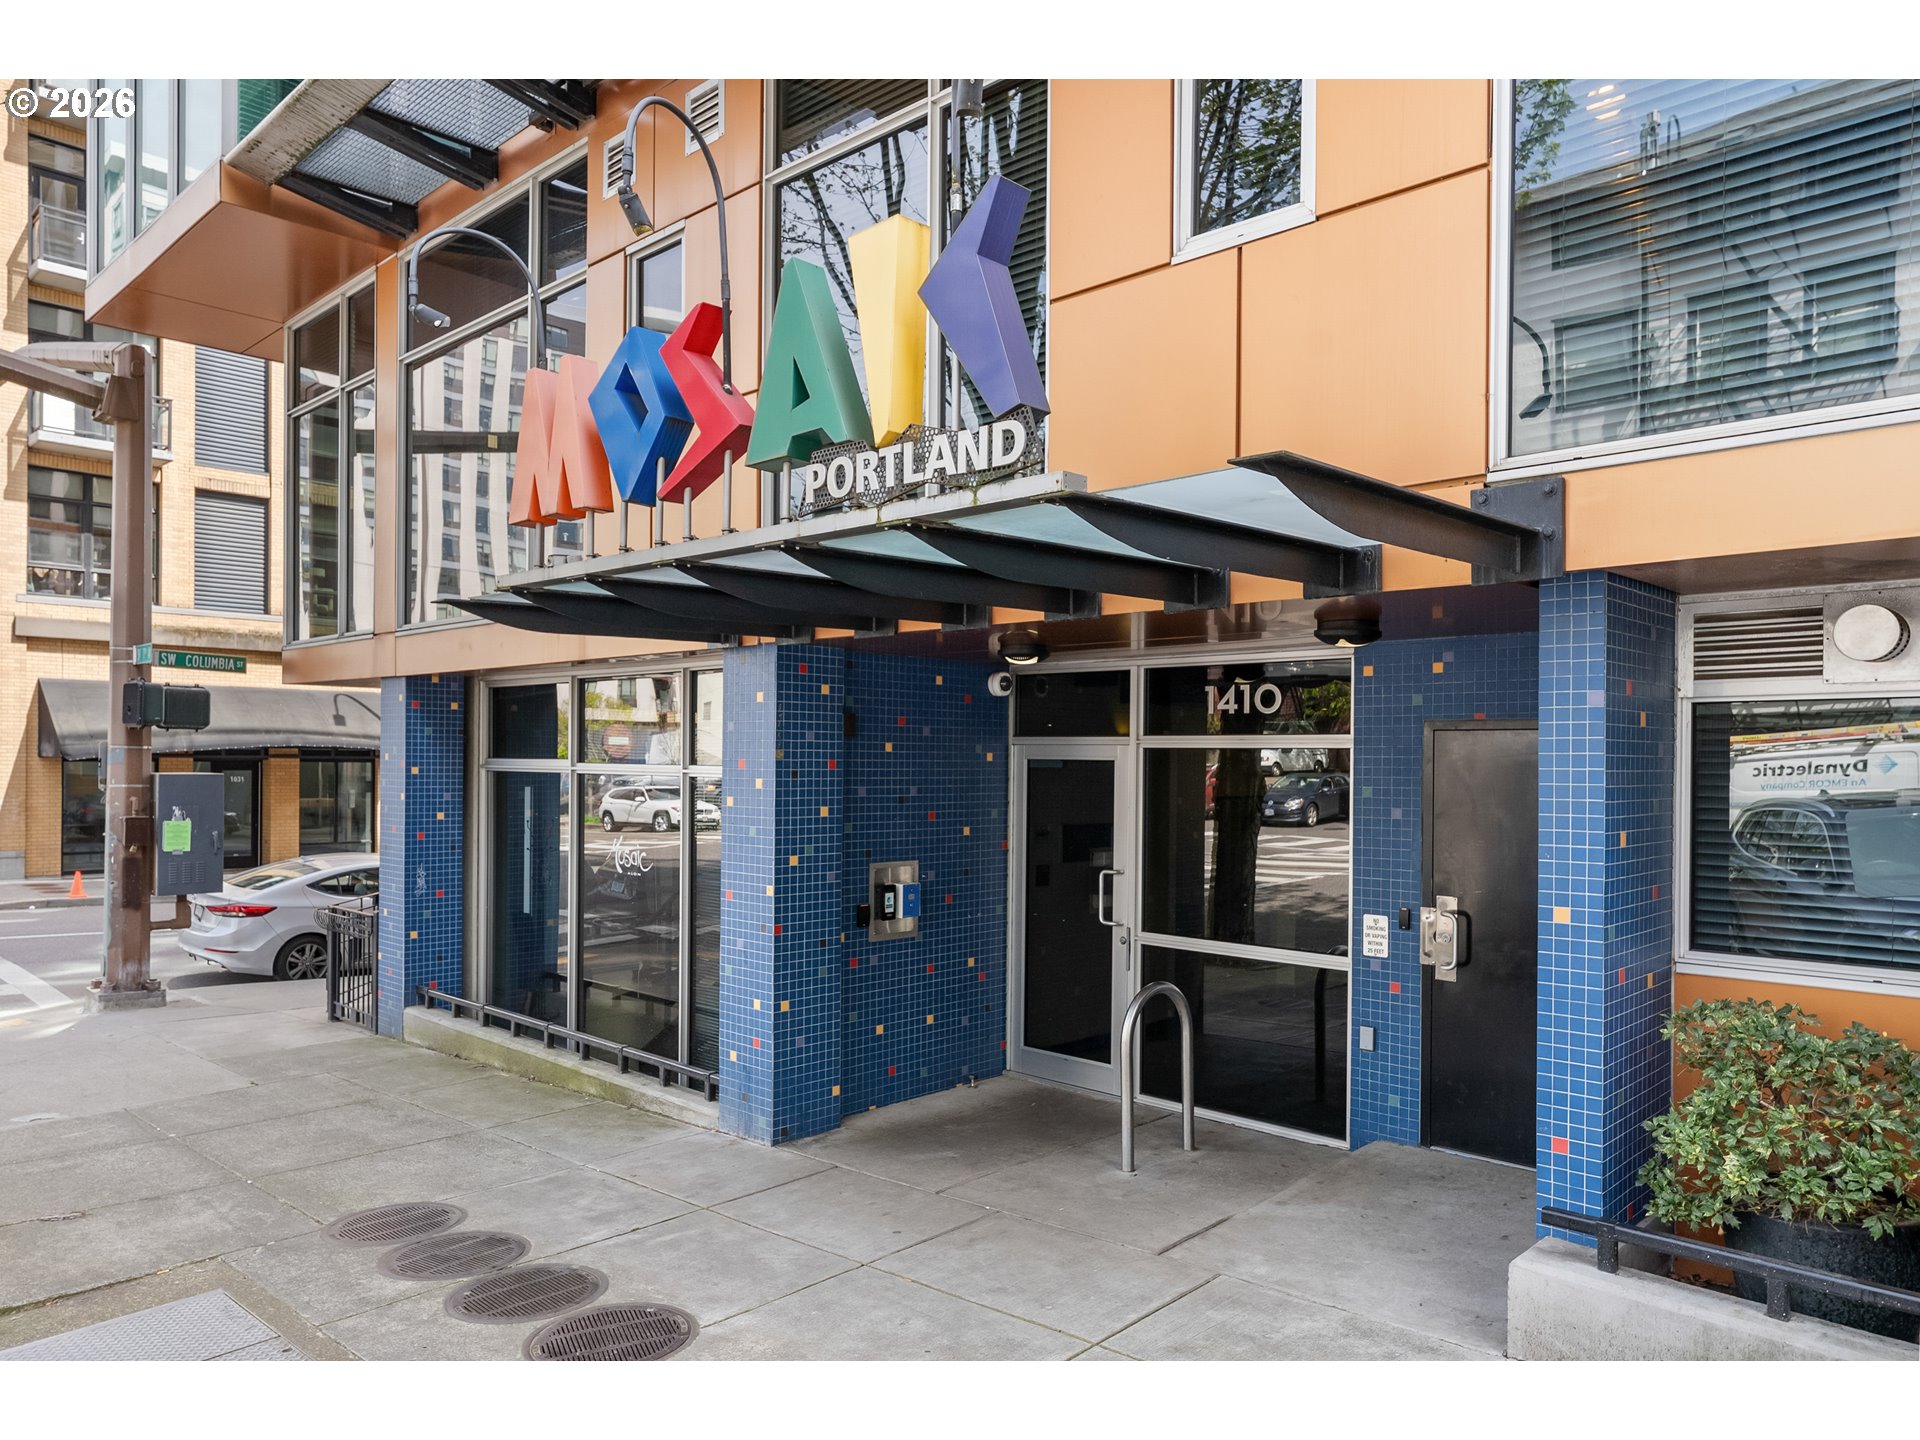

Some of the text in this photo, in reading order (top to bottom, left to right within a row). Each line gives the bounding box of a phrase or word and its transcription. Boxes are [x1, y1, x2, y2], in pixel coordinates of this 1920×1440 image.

[509, 175, 1051, 528] MOSAIC
[805, 420, 1026, 503] PORTLAND
[160, 652, 177, 666] SW
[185, 655, 235, 670] COLUMBIA
[1204, 683, 1282, 714] 1410
